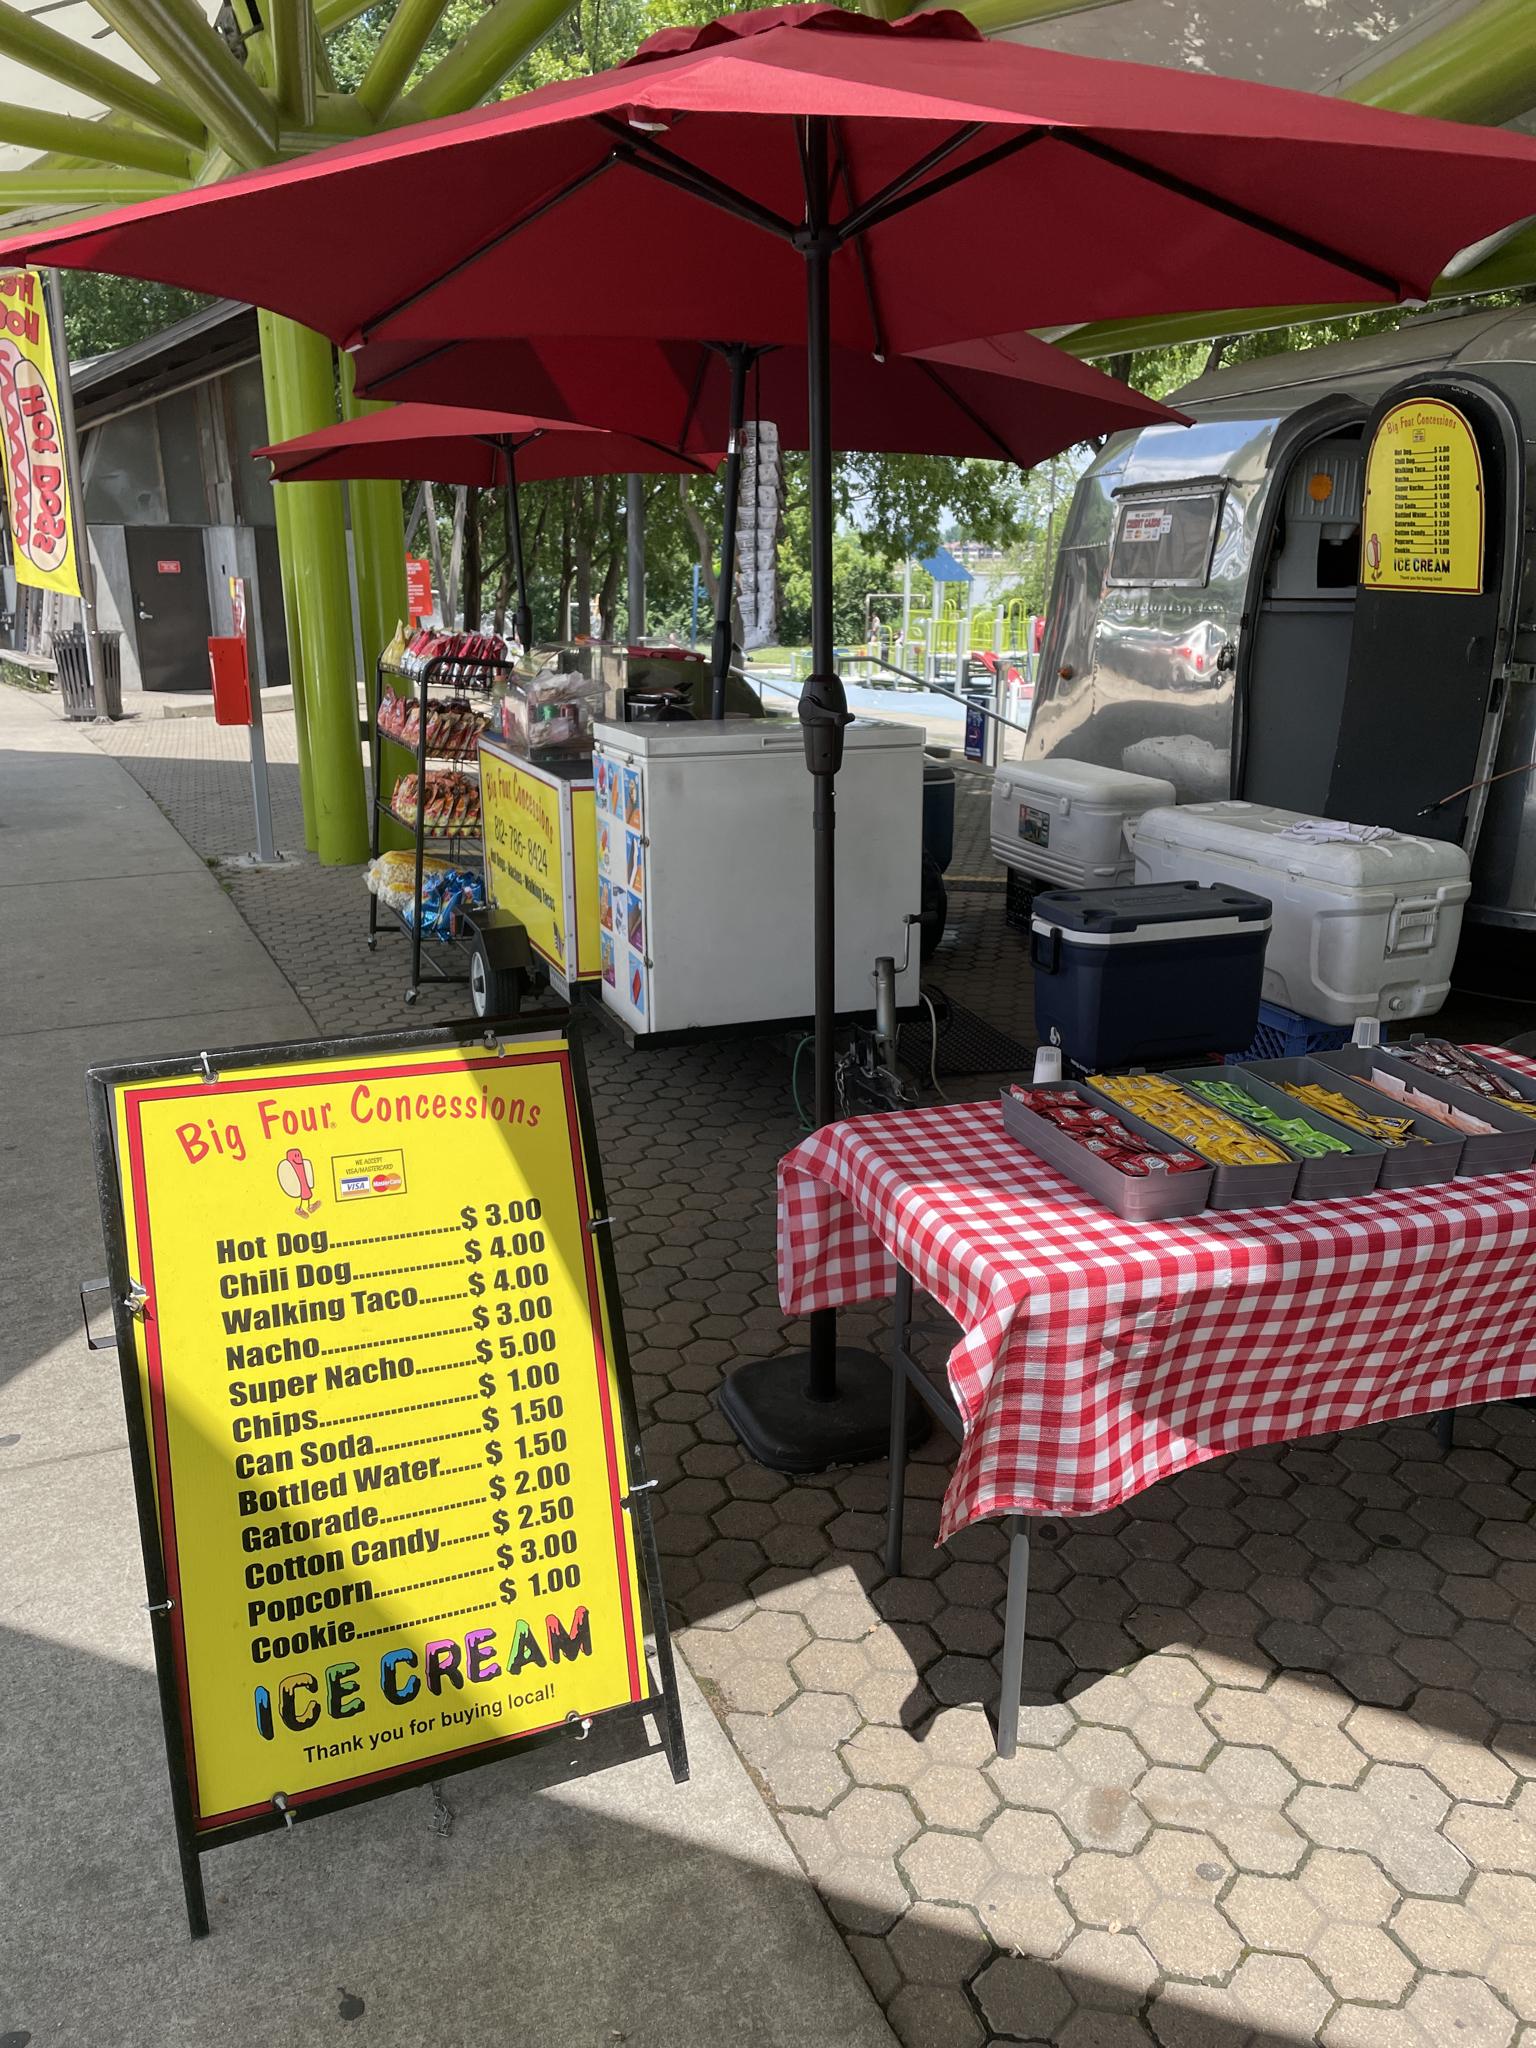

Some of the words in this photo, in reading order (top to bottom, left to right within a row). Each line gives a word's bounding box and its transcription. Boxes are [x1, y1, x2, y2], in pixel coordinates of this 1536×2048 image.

[1394, 559, 1411, 573] ICE
[1413, 559, 1450, 573] CREAM
[514, 772, 554, 845] Concessions
[175, 1122, 247, 1165] Big
[258, 1100, 331, 1140] Four
[350, 1084, 542, 1128] Concessions
[347, 1182, 365, 1191] VISA
[216, 1237, 268, 1264] Hot
[277, 1230, 329, 1257] Dog
[220, 1267, 289, 1299] Chili
[296, 1262, 352, 1289] Dog
[222, 1297, 346, 1335] Walking
[351, 1287, 418, 1315] Taco
[226, 1336, 320, 1371] Nacho
[229, 1372, 318, 1407] Super
[325, 1356, 414, 1391] Nacho
[232, 1408, 319, 1443] Chips
[236, 1450, 294, 1480] Can
[301, 1434, 374, 1466] Soda
[238, 1472, 347, 1516] Bottled
[354, 1455, 441, 1493] Water
[242, 1505, 379, 1553] Gatorade
[245, 1548, 344, 1590] Cotton
[351, 1526, 440, 1566] Candy
[248, 1578, 373, 1627] Popcorn
[251, 1618, 356, 1664] Cookie
[254, 1661, 366, 1741] ICE
[380, 1605, 593, 1706] CREAM
[303, 1730, 364, 1764] Thank
[369, 1728, 404, 1750] you
[409, 1713, 436, 1737] for
[441, 1700, 503, 1728] buying
[508, 1683, 556, 1710] local!
